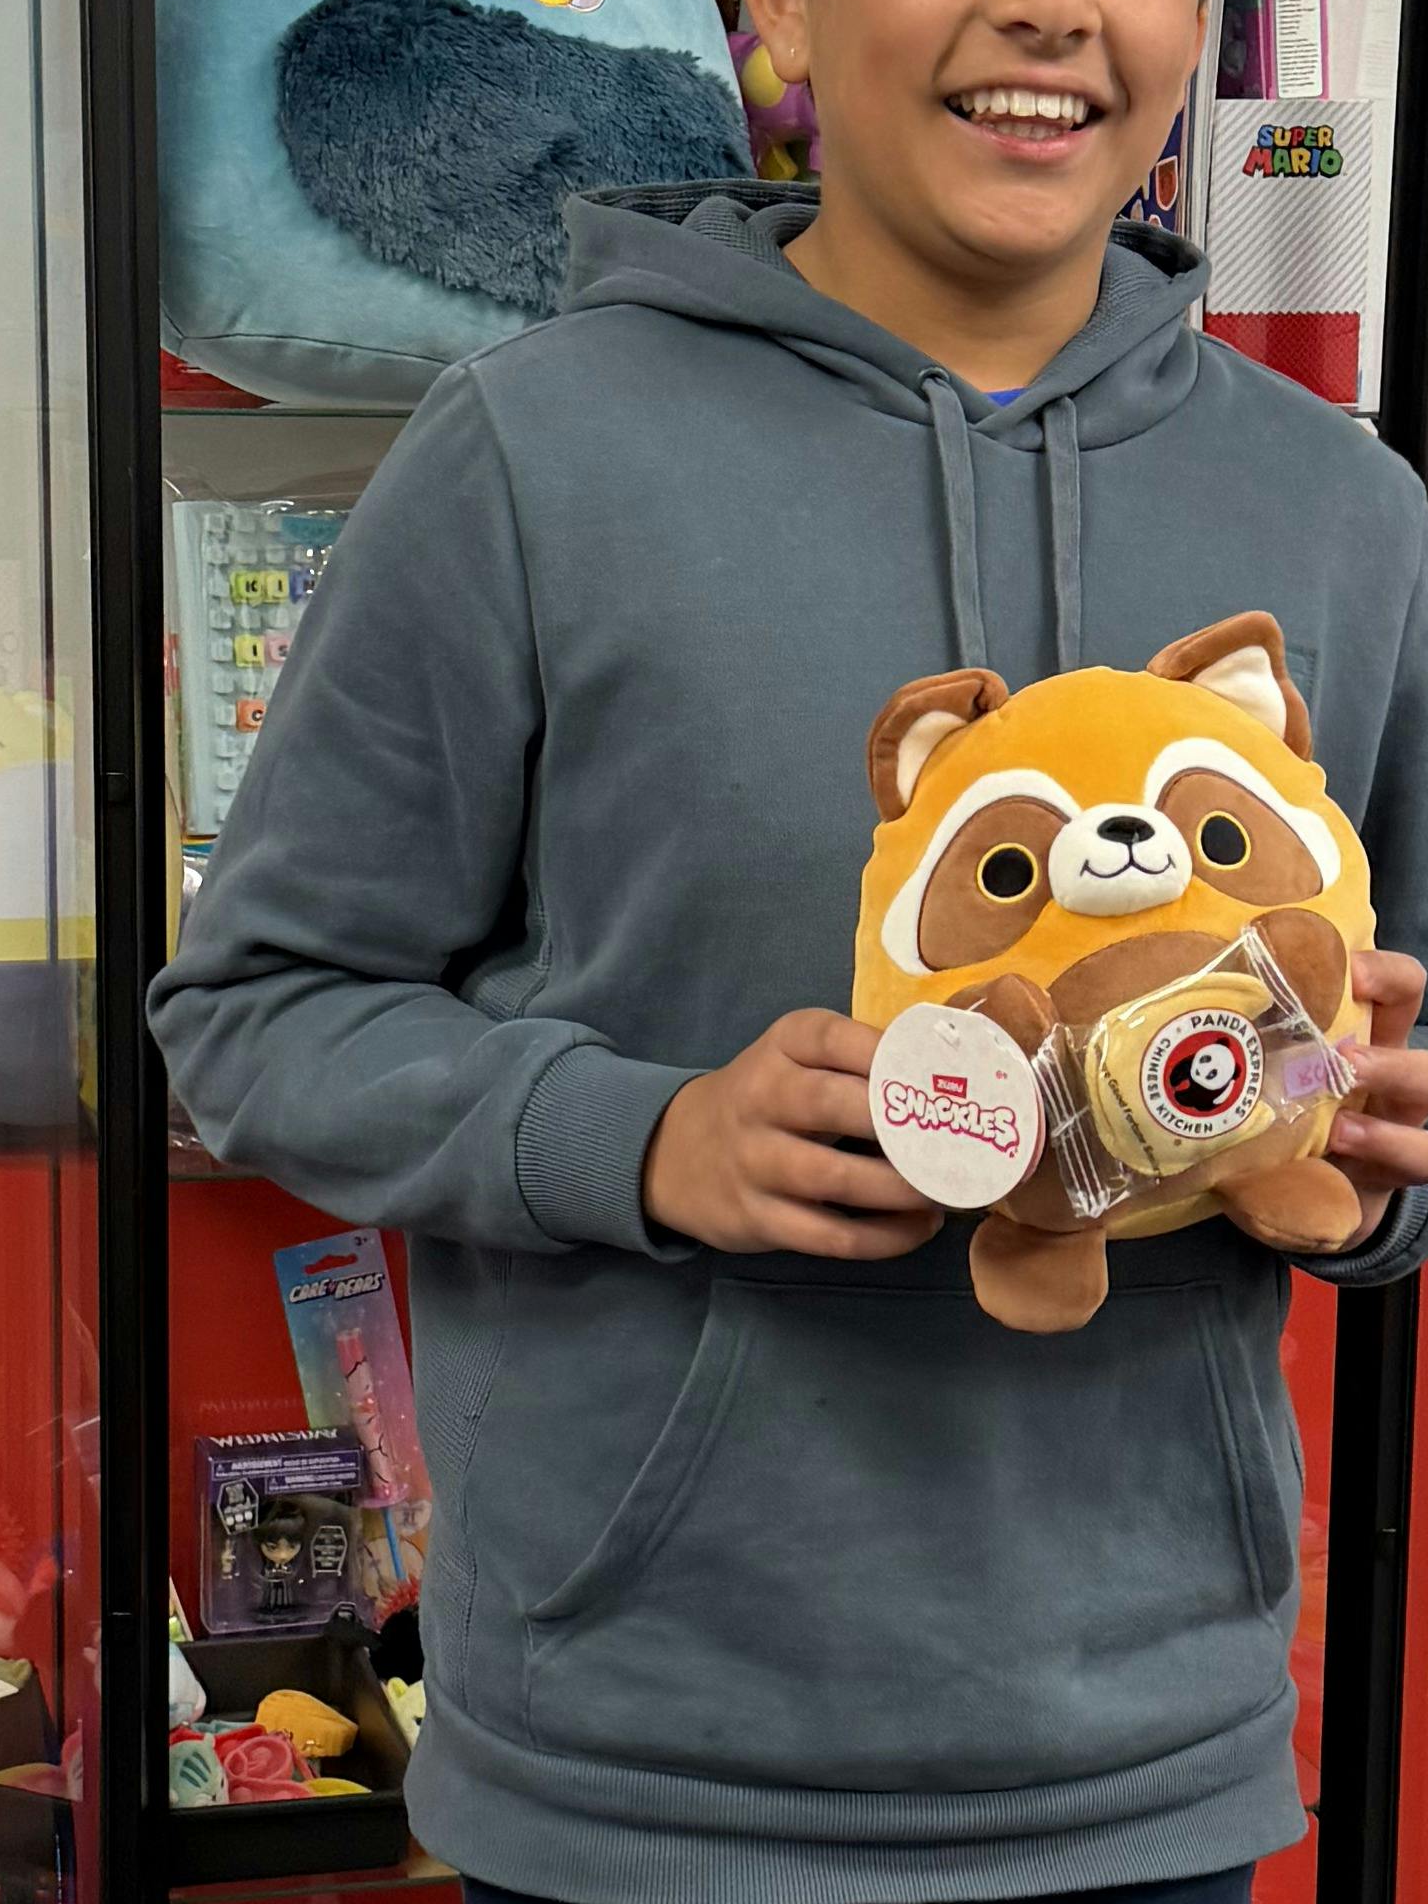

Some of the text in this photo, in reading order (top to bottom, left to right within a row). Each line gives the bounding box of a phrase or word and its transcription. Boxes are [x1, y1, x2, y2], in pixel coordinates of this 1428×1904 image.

[1256, 123, 1335, 148] SUPER
[1241, 145, 1345, 179] MARIO
[1146, 1037, 1173, 1102] CHINESE
[1189, 1012, 1263, 1119] PANDA EXPRESS
[883, 1080, 1021, 1153] SNACKLES
[1155, 1103, 1215, 1134] KITCHEN
[288, 1272, 385, 1304] CARE BEARS
